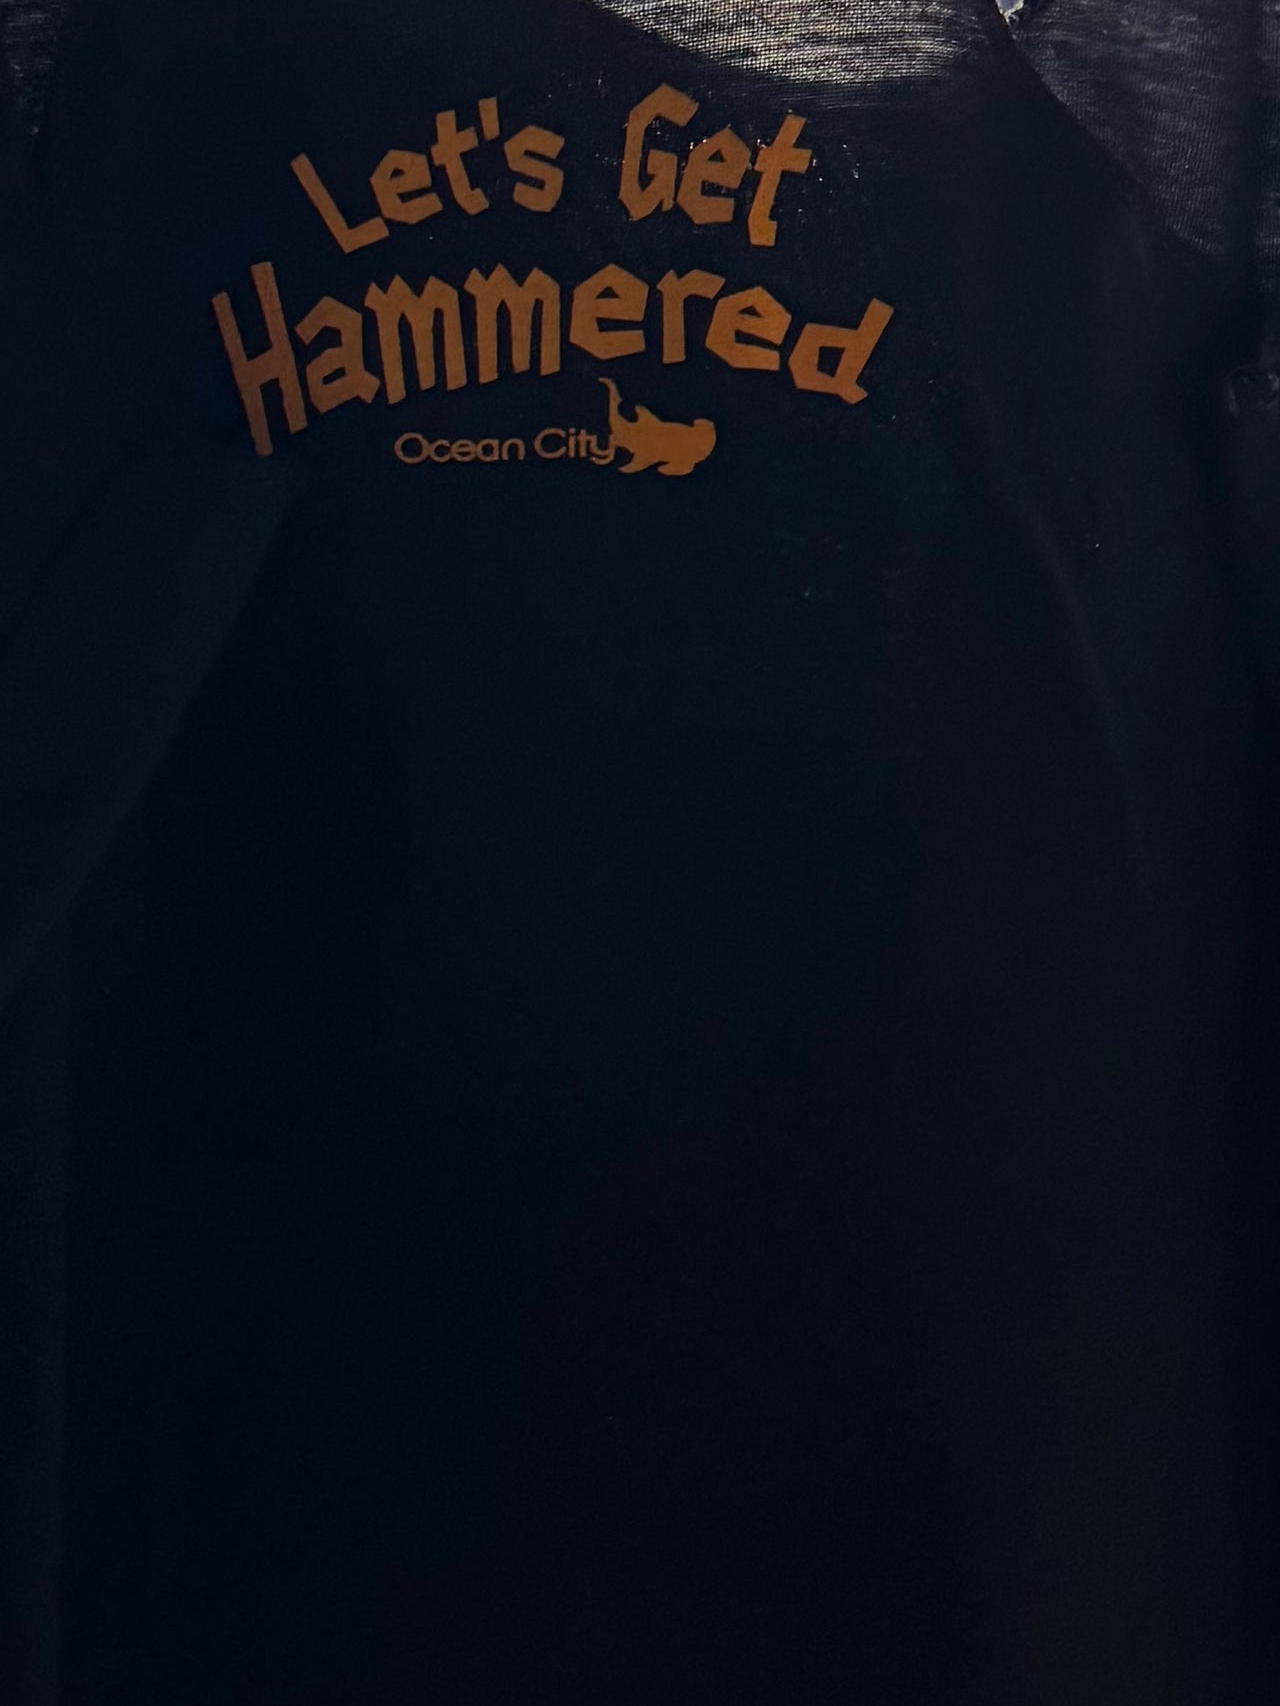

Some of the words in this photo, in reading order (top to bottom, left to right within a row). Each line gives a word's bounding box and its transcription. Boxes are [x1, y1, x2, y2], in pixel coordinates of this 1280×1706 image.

[291, 97, 565, 254] Let's
[619, 84, 813, 248] Get
[213, 261, 894, 456] Hammered
[393, 431, 525, 465] Ocean
[534, 426, 616, 465] City
